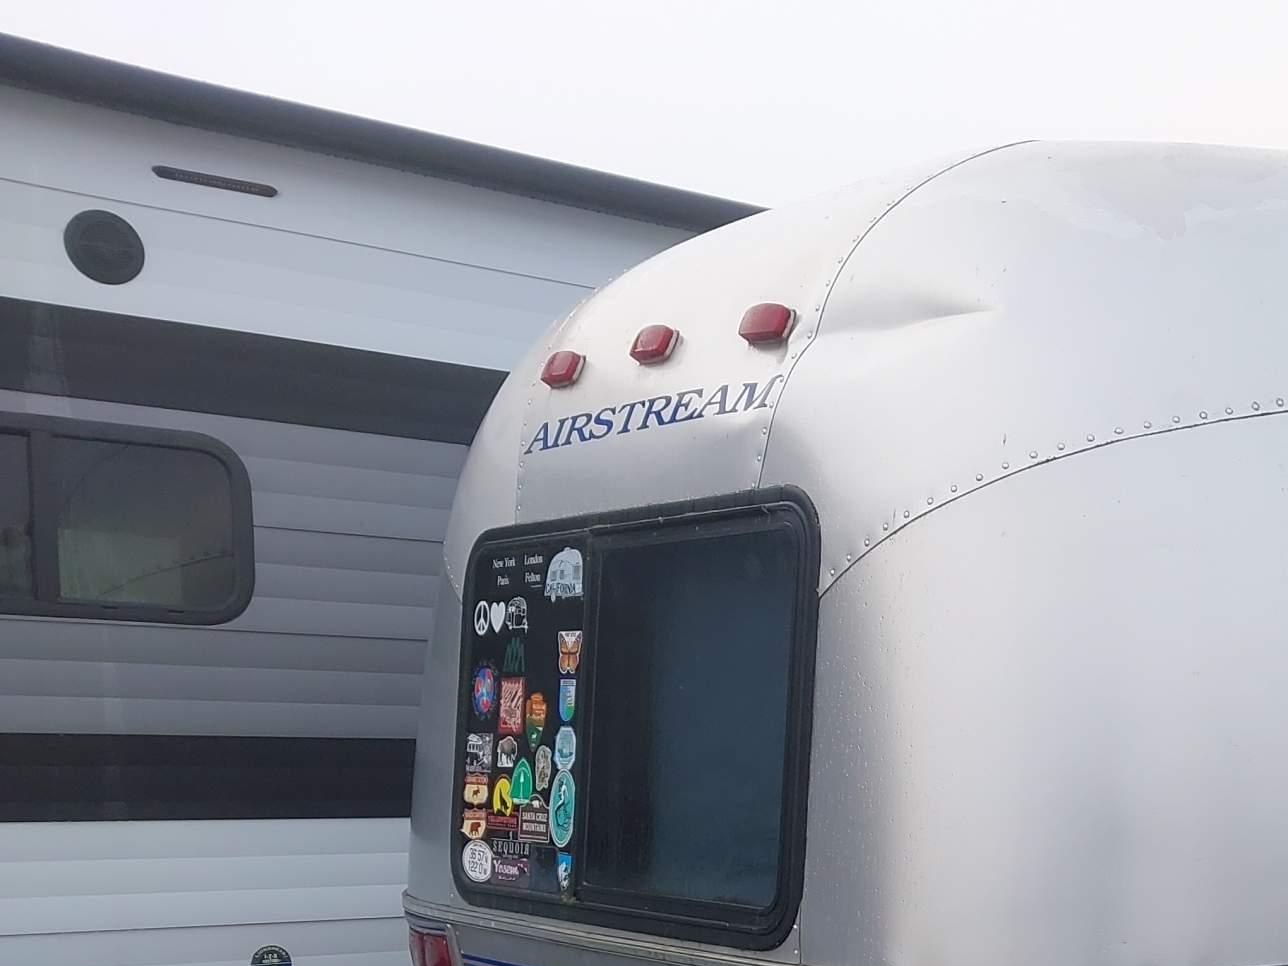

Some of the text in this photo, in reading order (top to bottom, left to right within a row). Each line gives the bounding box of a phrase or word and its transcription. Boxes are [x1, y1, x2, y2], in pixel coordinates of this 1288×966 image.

[524, 374, 784, 455] AIRSTREAM
[492, 557, 516, 569] New York
[524, 554, 544, 566] London
[497, 574, 510, 586] Paris
[525, 571, 541, 583] Felton
[545, 582, 577, 594] CALIFORNIA
[522, 811, 548, 822] SANTA CRUZ
[492, 840, 530, 856] SEQUOIA
